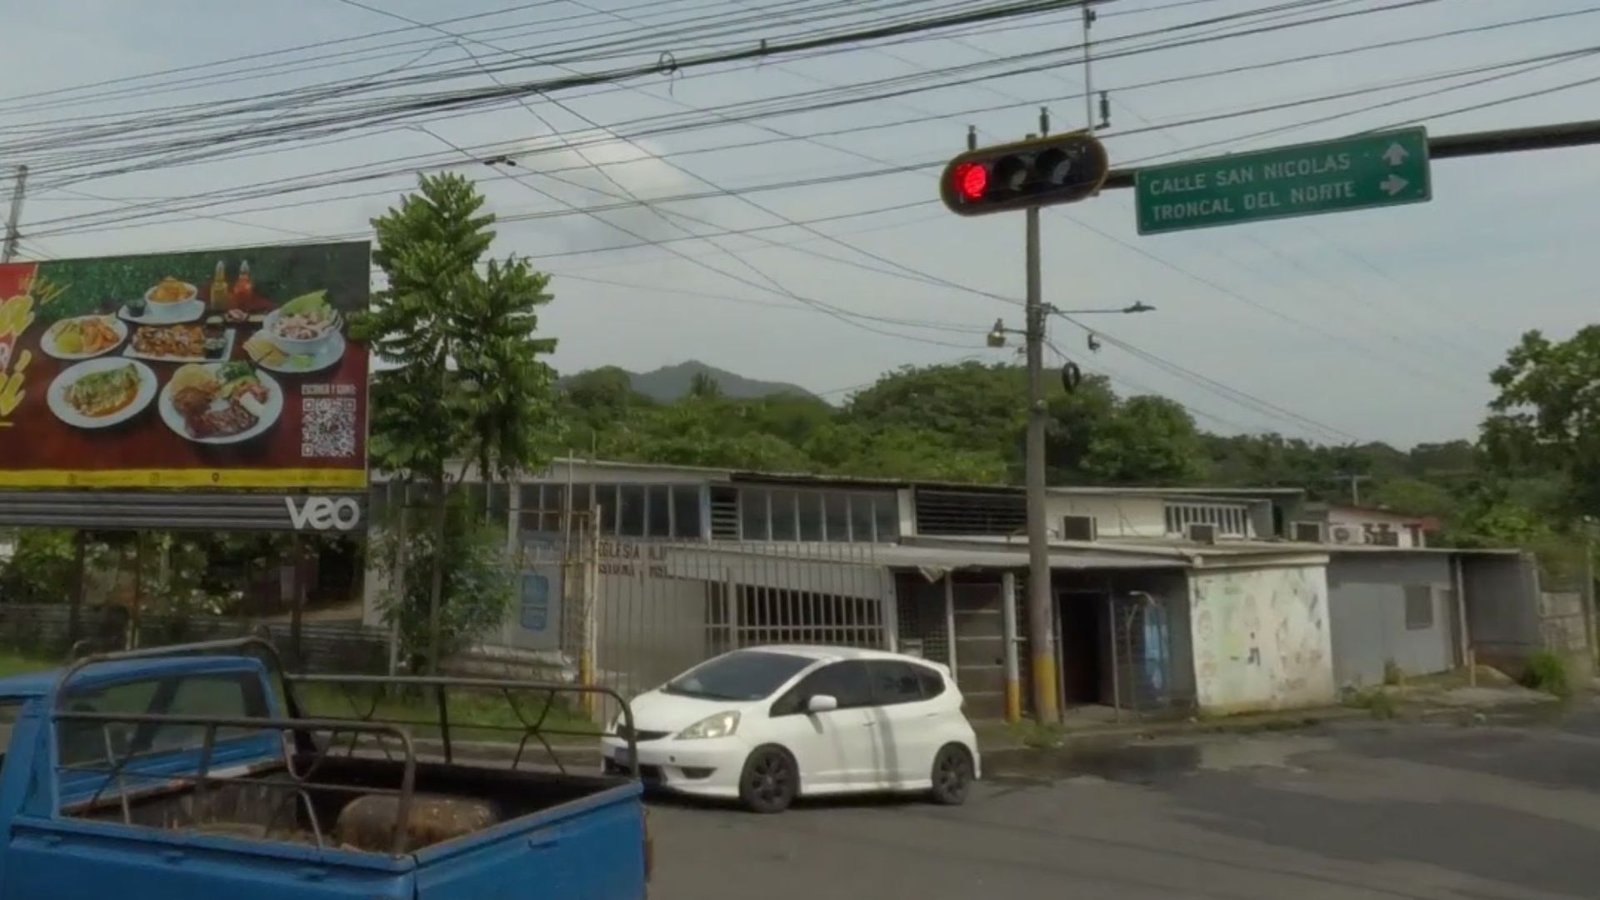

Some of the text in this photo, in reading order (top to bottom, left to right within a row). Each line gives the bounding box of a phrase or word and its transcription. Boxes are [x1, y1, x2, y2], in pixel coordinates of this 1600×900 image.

[1150, 153, 1350, 195] CALLE SAN NICOLAS
[1152, 181, 1356, 222] TRONCAL DEL NORTE
